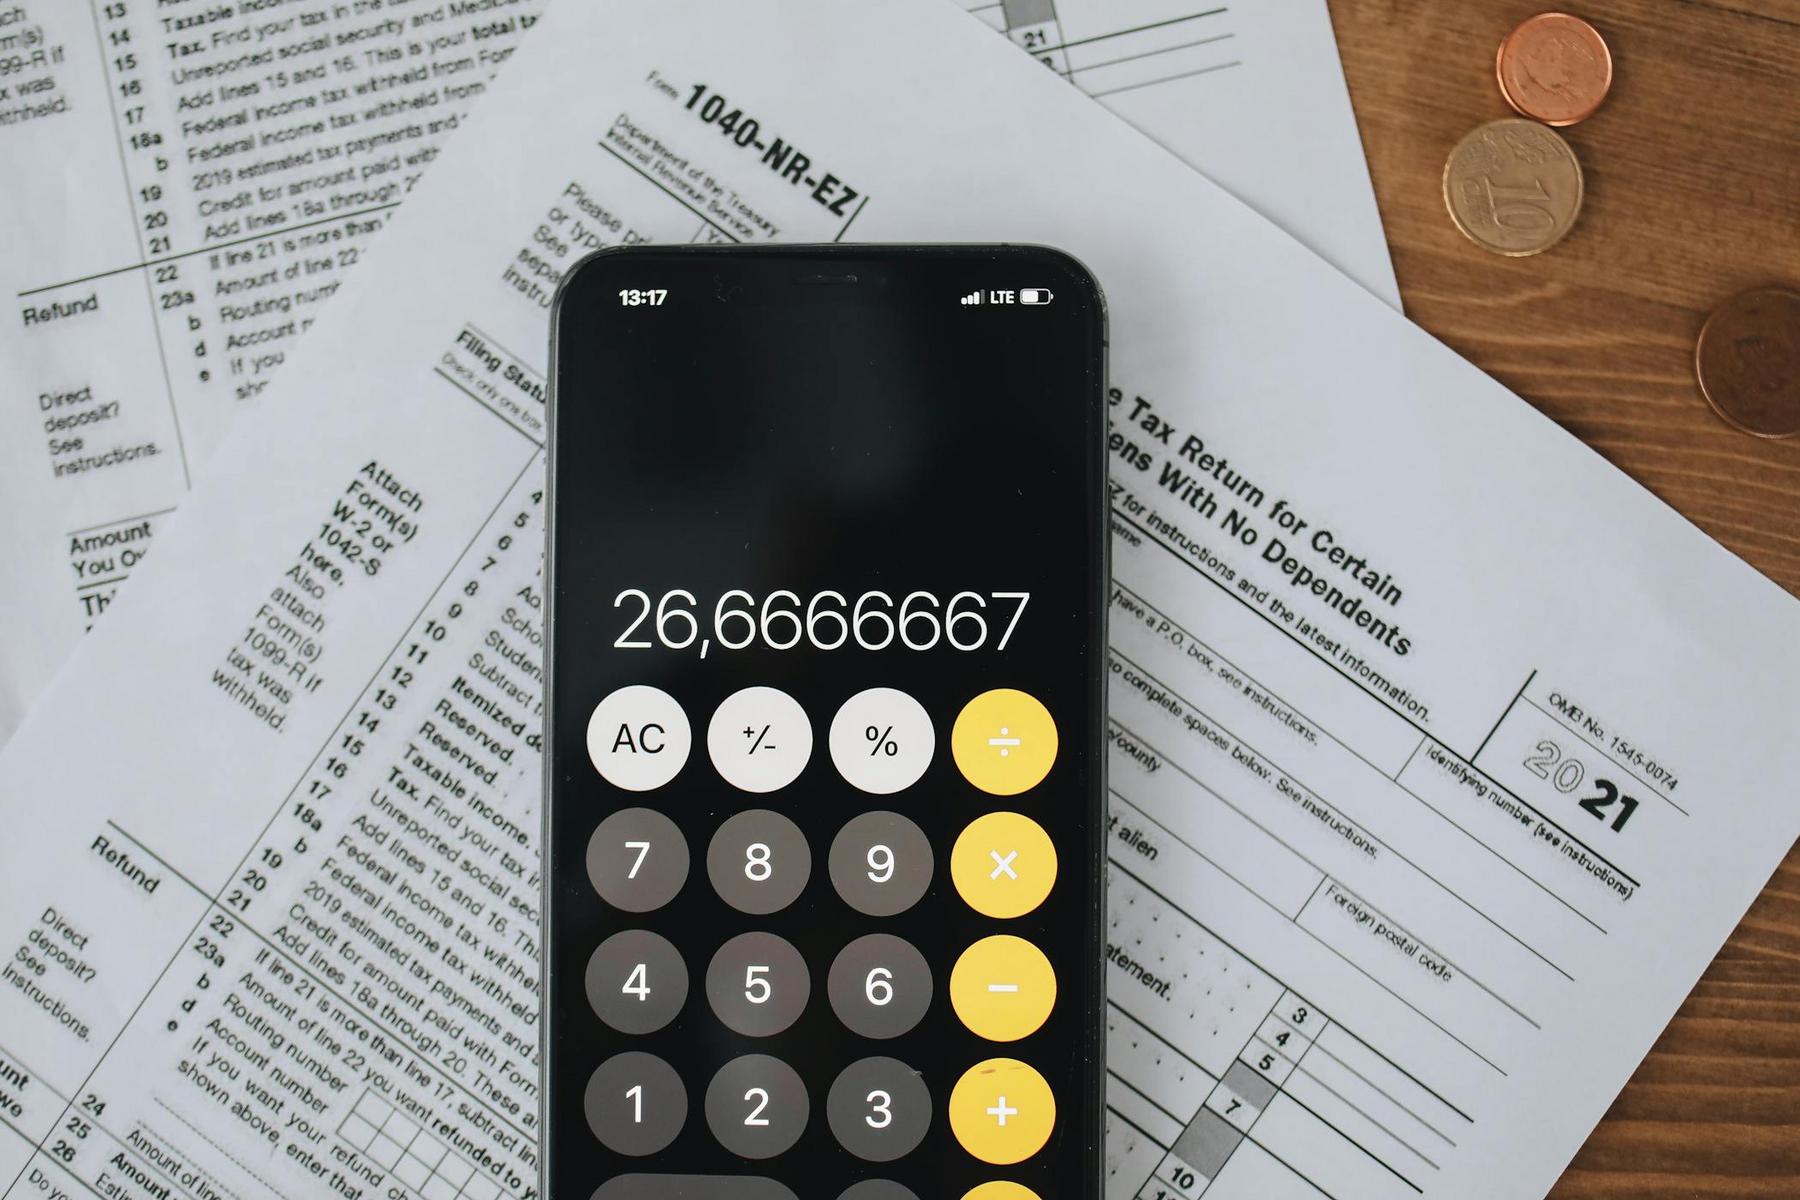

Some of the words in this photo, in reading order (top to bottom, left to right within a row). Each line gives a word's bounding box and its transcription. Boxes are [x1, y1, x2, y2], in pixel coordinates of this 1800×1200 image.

[109, 28, 131, 46] 14
[161, 6, 234, 33] Taxable
[1025, 29, 1048, 49] 21
[114, 53, 137, 72] 15
[124, 106, 145, 125] 17
[471, 17, 516, 41] total
[646, 70, 679, 100] Form
[685, 84, 859, 218] 1040-NR-EZ
[139, 185, 163, 203] 19
[605, 127, 654, 165] Internal
[651, 159, 715, 204] Revenue
[709, 199, 754, 238] Service
[610, 113, 689, 171] Department
[687, 168, 705, 181] of
[703, 176, 724, 197] the
[725, 192, 780, 238] Treasury
[144, 210, 169, 231] 20
[547, 207, 570, 225] or
[562, 181, 623, 233] Please
[149, 235, 171, 255] 21
[533, 224, 569, 258] See
[155, 264, 179, 284] 22
[21, 293, 99, 327] Refund
[619, 289, 667, 306] 13:17
[990, 290, 1014, 305] LTE
[456, 330, 501, 374] Filing
[38, 386, 93, 412] Direct
[44, 401, 120, 434] deposit?
[48, 437, 84, 456] See
[53, 442, 161, 478] instructions.
[360, 461, 423, 513] Attach
[531, 490, 544, 505] 4
[1128, 395, 1176, 445] Tax
[1178, 434, 1265, 508] Return
[1268, 499, 1308, 536] for
[1311, 530, 1403, 607] Certain
[332, 499, 372, 539] W-2
[371, 535, 394, 554] or
[345, 480, 419, 544] Form(s)
[513, 511, 530, 529] 5
[70, 521, 152, 556] Amount
[319, 523, 382, 576] 1042-S
[497, 535, 513, 551] 6
[71, 557, 116, 579] You
[481, 556, 497, 572] 7
[1157, 460, 1218, 519] With
[1220, 508, 1258, 546] No
[1261, 537, 1412, 656] Dependents
[285, 564, 325, 600] Also
[463, 580, 479, 597] 8
[270, 587, 325, 633] attach
[447, 602, 463, 619] 9
[612, 589, 1031, 659] 26,6666667
[1121, 493, 1147, 517] for
[1145, 509, 1236, 581] instructions
[1237, 578, 1270, 604] and
[1268, 598, 1295, 623] the
[1295, 617, 1342, 657] latest
[1339, 648, 1429, 723] information.
[252, 603, 323, 664] Form(s)
[226, 647, 255, 677] tax
[257, 671, 291, 705] was
[243, 627, 308, 683] 1099-R
[304, 674, 323, 693] if
[424, 620, 446, 642] 10
[468, 652, 534, 709] Subtract
[1112, 590, 1145, 619] have
[1145, 616, 1156, 628] a
[1155, 620, 1184, 649] P.O.
[1217, 667, 1243, 689] see
[1242, 685, 1317, 746] instructions.
[212, 668, 286, 733] withheld.
[375, 689, 397, 710] 13
[407, 644, 429, 665] 11
[450, 675, 527, 737] Itemized
[391, 666, 413, 689] 12
[434, 698, 515, 766] Reserved.
[612, 723, 666, 754] AC
[1548, 693, 1584, 723] OMB
[1582, 716, 1604, 742] No.
[1610, 736, 1679, 791] 1545-0074
[1122, 661, 1183, 717] complete
[1182, 714, 1230, 751] spaces
[1231, 745, 1272, 784] below.
[1275, 777, 1302, 802] See
[1301, 794, 1378, 860] instructions.
[309, 780, 332, 800] 17
[342, 734, 365, 756] 15
[388, 765, 419, 801] Tax.
[423, 794, 464, 830] Find
[358, 712, 380, 733] 14
[403, 743, 467, 799] Taxable
[467, 792, 530, 850] income.
[293, 803, 323, 833] 18a
[326, 757, 348, 779] 16
[370, 788, 463, 863] Unreported
[459, 859, 512, 900] social
[1426, 744, 1489, 797] Identifying
[1487, 791, 1535, 827] number
[1533, 822, 1561, 847] (see
[1560, 840, 1634, 902] instructions)
[624, 841, 651, 879] 7
[743, 843, 772, 882] 8
[1117, 826, 1158, 861] alien
[90, 835, 161, 894] Refund
[242, 869, 267, 892] 20
[866, 845, 895, 883] 9
[227, 889, 252, 912] 21
[40, 906, 89, 951] Direct
[209, 914, 235, 939] 22
[261, 848, 283, 869] 19
[303, 880, 343, 914] 2019
[341, 910, 412, 967] estimated
[429, 978, 502, 1036] payments
[1325, 884, 1385, 928] Foreign
[1373, 923, 1420, 957] postal
[1418, 948, 1461, 982] code
[15, 945, 47, 977] See
[28, 929, 97, 984] deposit?
[1, 961, 90, 1042] instructions.
[622, 964, 651, 1002] 4
[744, 965, 772, 1003] 5
[864, 968, 894, 1006] 6
[1291, 1007, 1308, 1024] 3
[222, 992, 286, 1050] Routing
[285, 1043, 349, 1093] number
[1275, 1031, 1291, 1047] 4
[193, 936, 226, 968] 23a
[238, 972, 298, 1022] Amount
[361, 1067, 394, 1097] you
[395, 1089, 433, 1123] want
[431, 1118, 507, 1176] refunded
[503, 1169, 522, 1190] to
[205, 1018, 271, 1071] Account
[269, 1067, 329, 1114] number
[1258, 1053, 1276, 1071] 5
[81, 1093, 106, 1117] 24
[625, 1086, 642, 1123] 1
[743, 1088, 769, 1126] 2
[864, 1090, 892, 1129] 3
[1225, 1098, 1242, 1115] 7
[51, 1139, 77, 1163] 26
[65, 1116, 92, 1140] 25
[110, 1152, 171, 1200] Amount
[1171, 1167, 1195, 1190] 10
